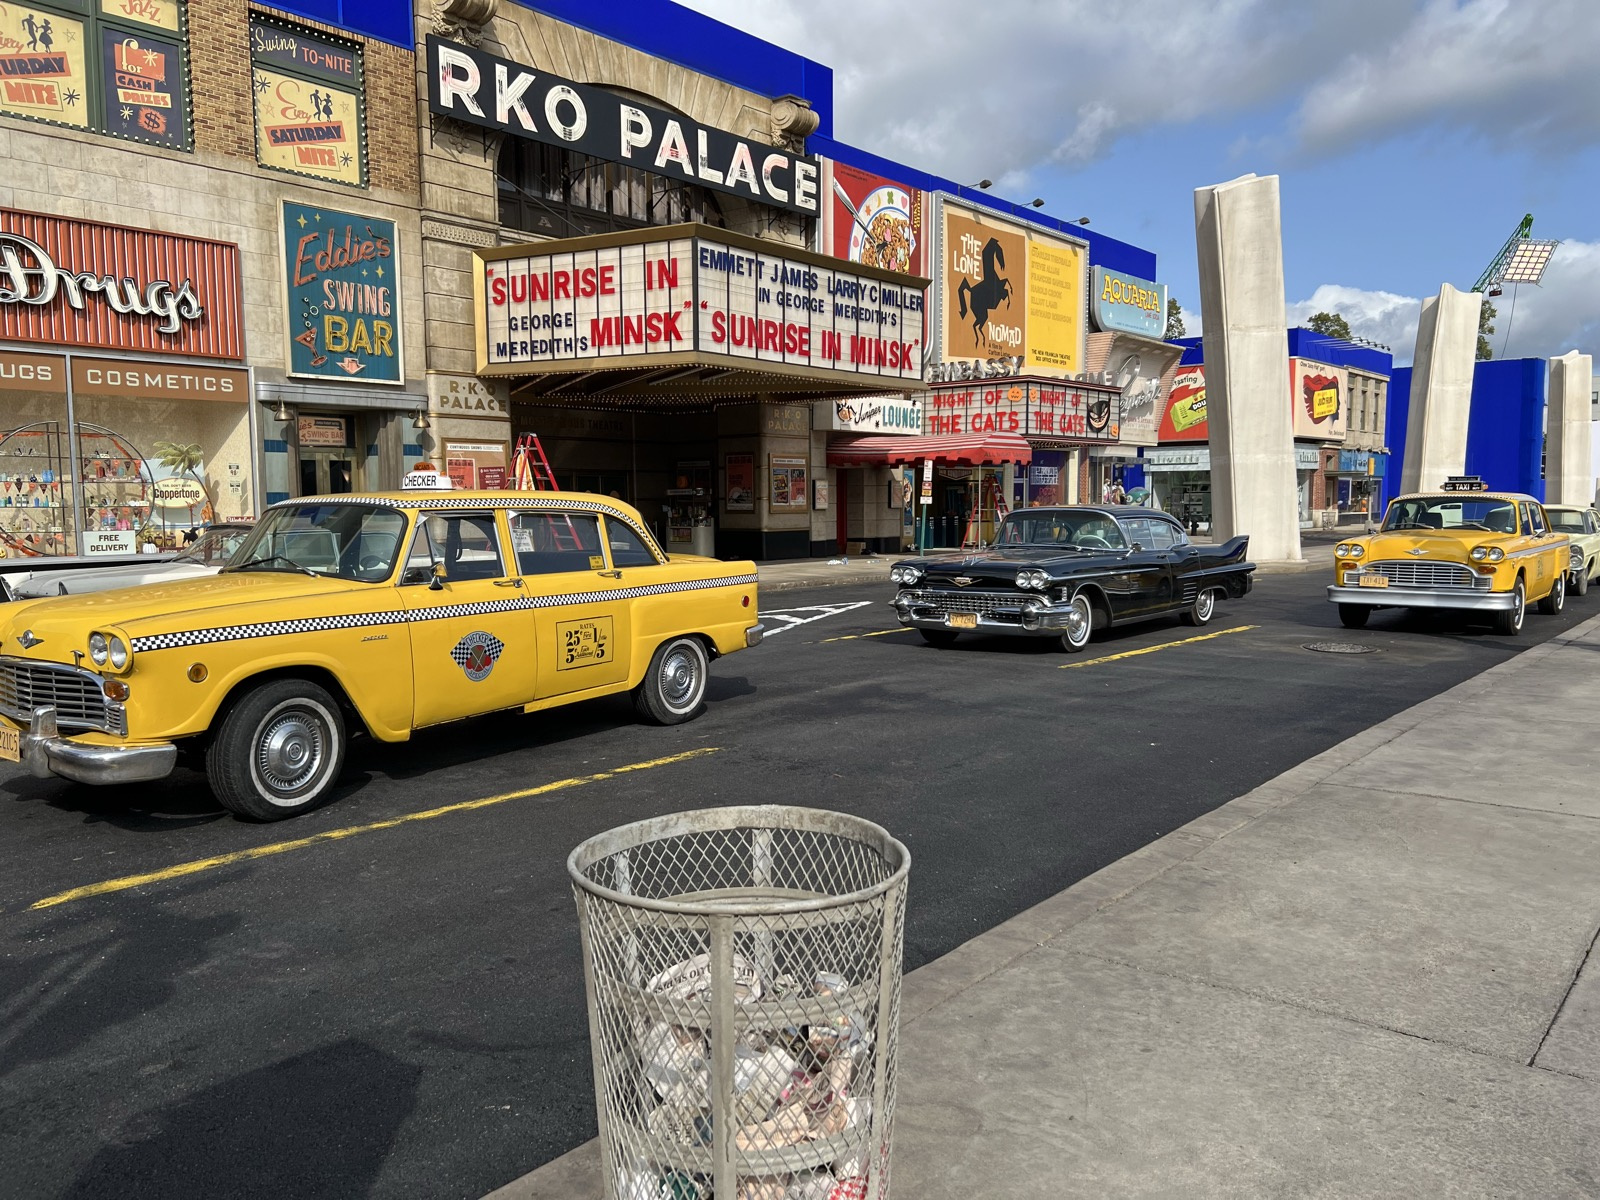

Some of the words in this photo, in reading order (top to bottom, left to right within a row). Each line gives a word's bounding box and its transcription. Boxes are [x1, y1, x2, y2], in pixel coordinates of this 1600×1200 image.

[255, 27, 297, 58] Swing
[121, 38, 143, 74] for
[302, 46, 352, 74] TO-NITE
[4, 81, 59, 106] NITE
[117, 75, 152, 91] CASH
[122, 91, 169, 107] PRIZES
[275, 80, 312, 123] Every
[270, 125, 342, 143] SATURDAY
[437, 44, 587, 142] RKO
[619, 103, 817, 211] PALACE
[297, 146, 336, 167] NITE
[293, 225, 392, 288] Eddie's
[960, 233, 982, 260] THE
[646, 257, 679, 291] IN
[954, 250, 982, 280] LONE
[0, 231, 203, 334] Drugs
[699, 246, 765, 280] EMMETT
[770, 263, 818, 290] JAMES
[828, 276, 868, 299] LARRY
[869, 285, 878, 303] C
[882, 288, 924, 312] MILLER
[323, 278, 391, 317] SWING
[1102, 274, 1160, 313] AQUARIA
[759, 287, 770, 303] IN
[776, 291, 825, 313] GEORGE
[835, 303, 897, 326] MEREDITH'S
[510, 312, 573, 331] GEORGE
[988, 321, 1022, 347] NOMAD
[323, 314, 394, 357] BAR
[496, 335, 588, 356] MEREDITH'S
[821, 330, 841, 360] IN
[86, 368, 234, 393] COSMETICS
[928, 355, 1024, 383] EMBASSY
[440, 395, 507, 411] PALACE
[933, 391, 974, 408] NIGHT
[984, 389, 1003, 405] OF
[1040, 389, 1066, 406] NIGHT
[1071, 393, 1082, 408] OF
[1192, 400, 1206, 410] DOU
[768, 420, 807, 431] PALACE
[882, 405, 921, 429] LOUNGE
[929, 414, 962, 434] THE
[971, 410, 1019, 432] CATS
[1034, 410, 1054, 432] THE
[1060, 413, 1085, 435] CATS
[306, 430, 329, 439] SWING
[330, 431, 344, 440] BAR
[404, 475, 437, 487] CHECKER
[1456, 483, 1470, 491] TAXI
[155, 488, 200, 500] Coppertone
[90, 543, 129, 552] DELIVERY
[99, 534, 120, 542] FREE
[464, 632, 490, 650] CHECKER
